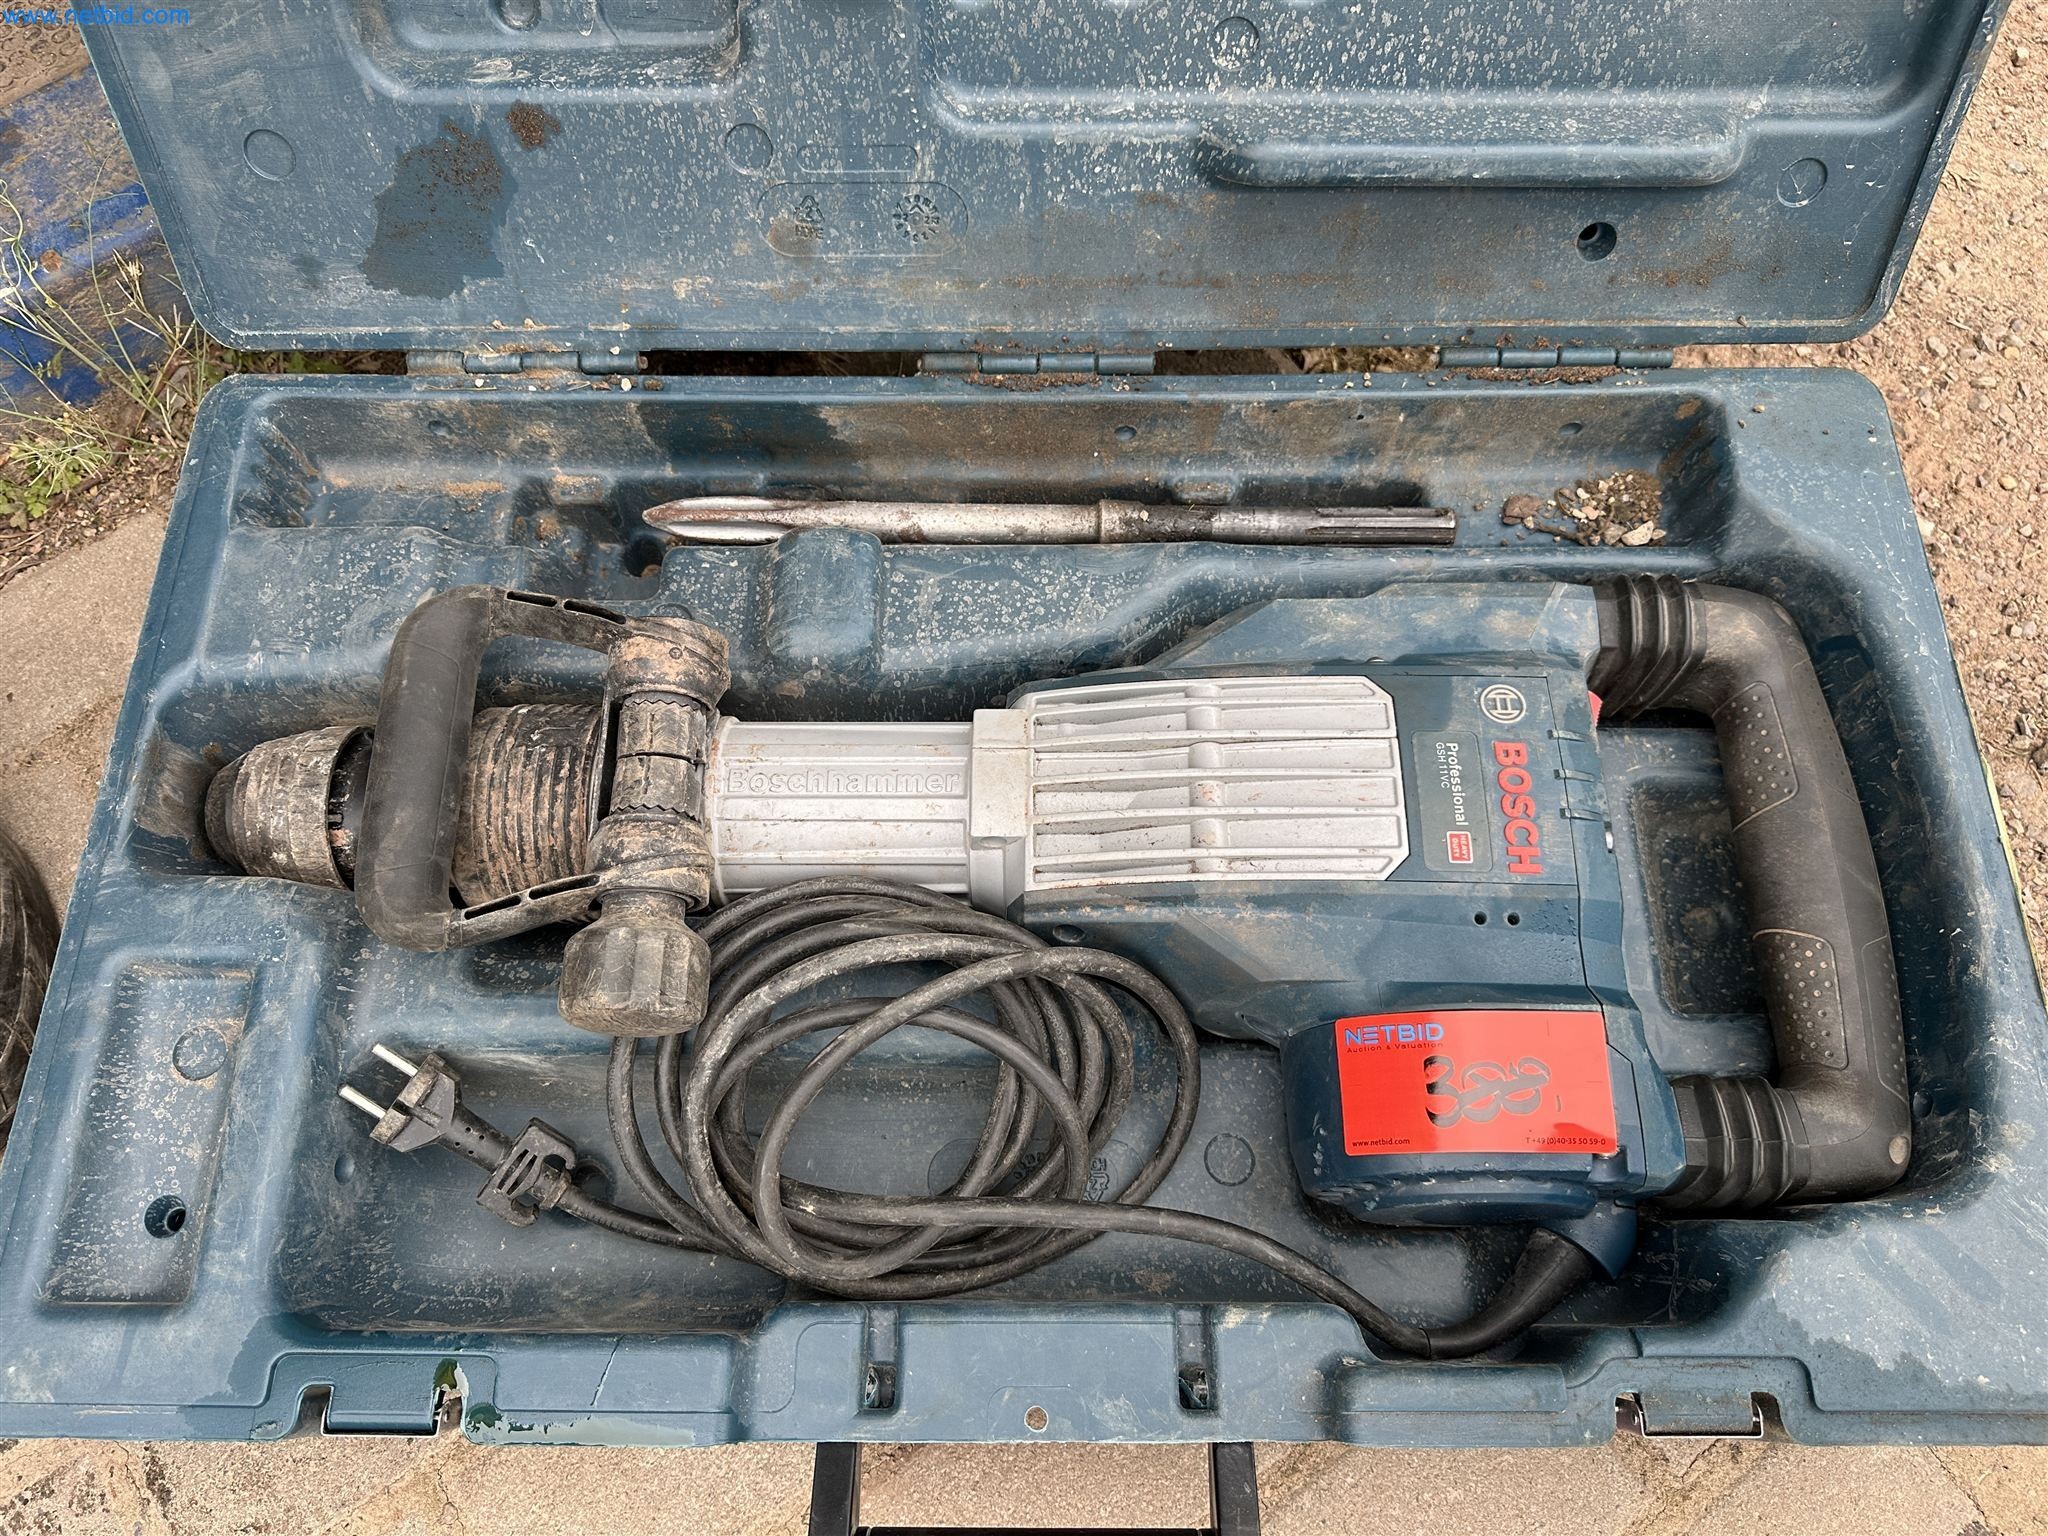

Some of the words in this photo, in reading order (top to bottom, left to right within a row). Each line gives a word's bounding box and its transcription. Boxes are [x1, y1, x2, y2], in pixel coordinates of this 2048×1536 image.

[1435, 742, 1446, 762] GSH
[726, 768, 960, 794] Boschhammer
[1446, 742, 1469, 826] Professional
[1492, 740, 1544, 875] BOSCH
[1452, 837, 1461, 858] DUTY
[1460, 834, 1470, 860] HEAVY
[1344, 1023, 1445, 1046] NETBID
[1346, 1044, 1382, 1053] Auction
[1394, 1042, 1444, 1050] Valuation
[1352, 1137, 1411, 1147] www.netbid.com
[1589, 1136, 1606, 1145] 59-0
